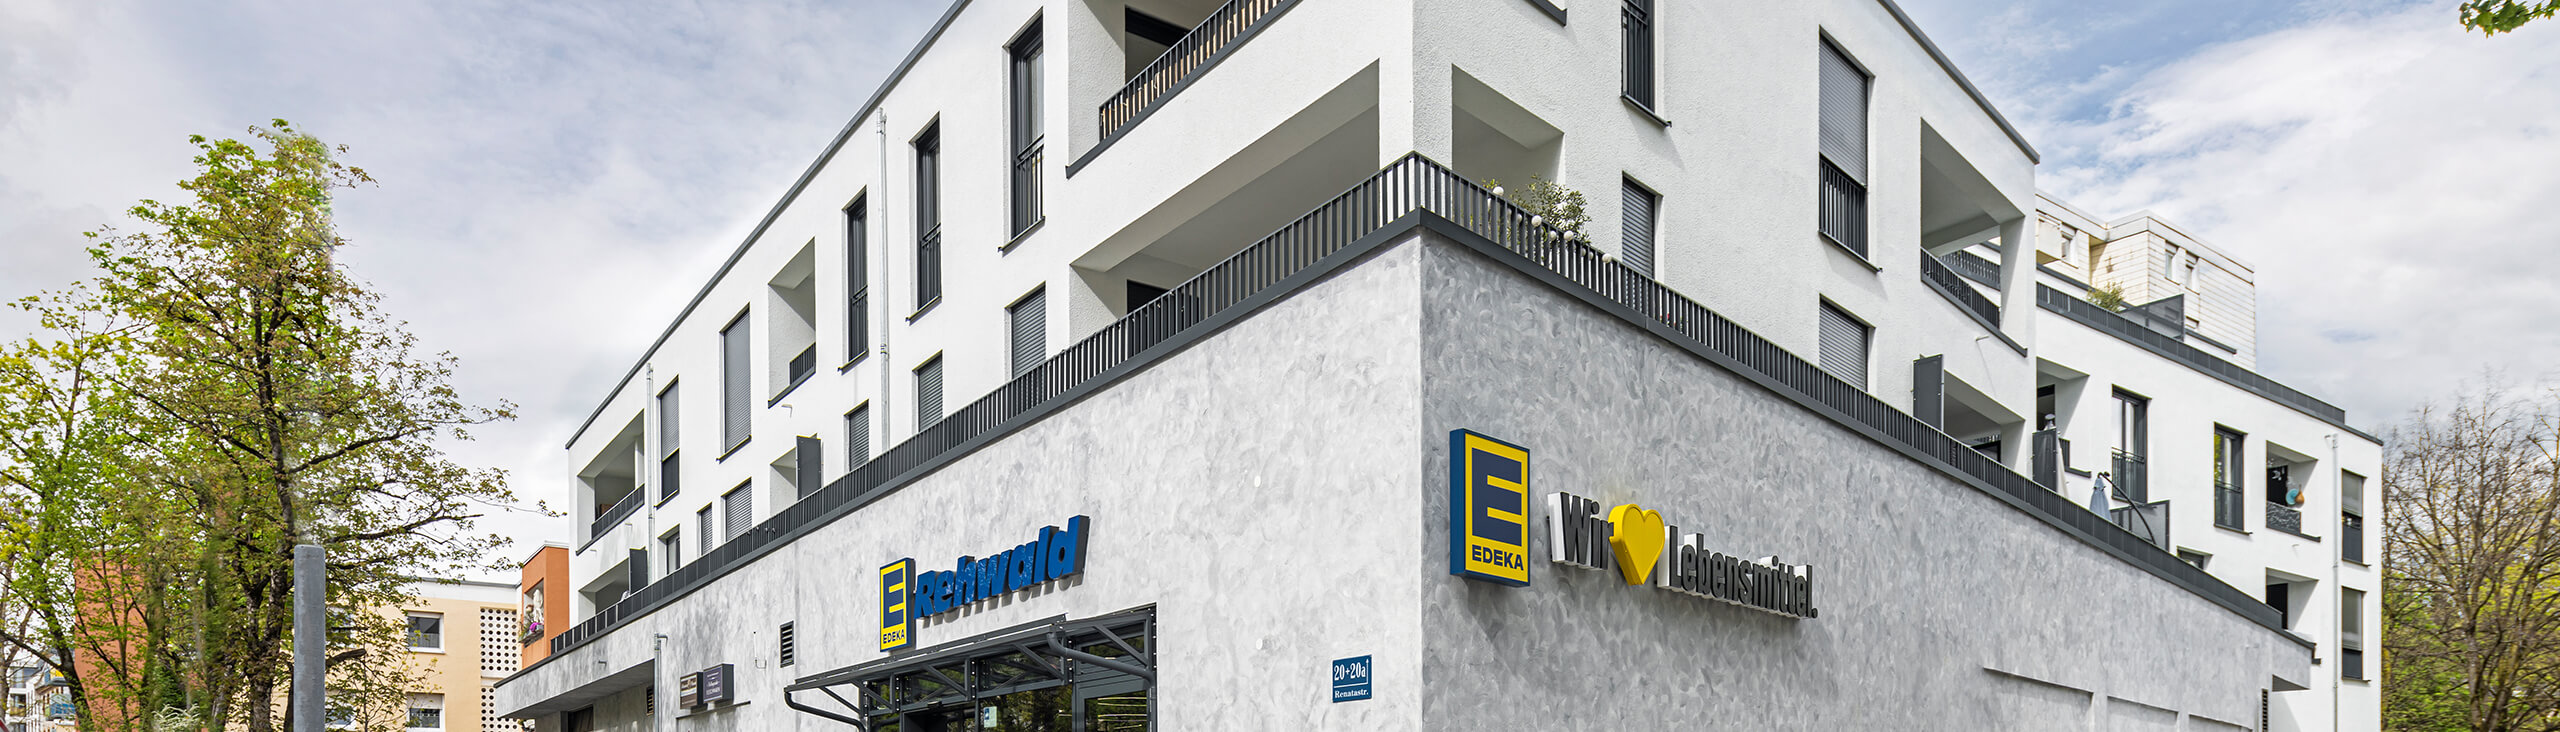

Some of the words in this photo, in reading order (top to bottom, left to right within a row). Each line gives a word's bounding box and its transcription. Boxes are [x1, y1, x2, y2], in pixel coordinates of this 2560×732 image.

[1472, 448, 1522, 546] E
[914, 515, 1083, 619] Rehwald
[1472, 544, 1525, 572] EDEKA
[1557, 492, 1614, 569] Wir
[1667, 525, 1819, 619] Lebensmittel.
[883, 629, 905, 644] EDEKA
[1335, 689, 1369, 698] Renatastr.
